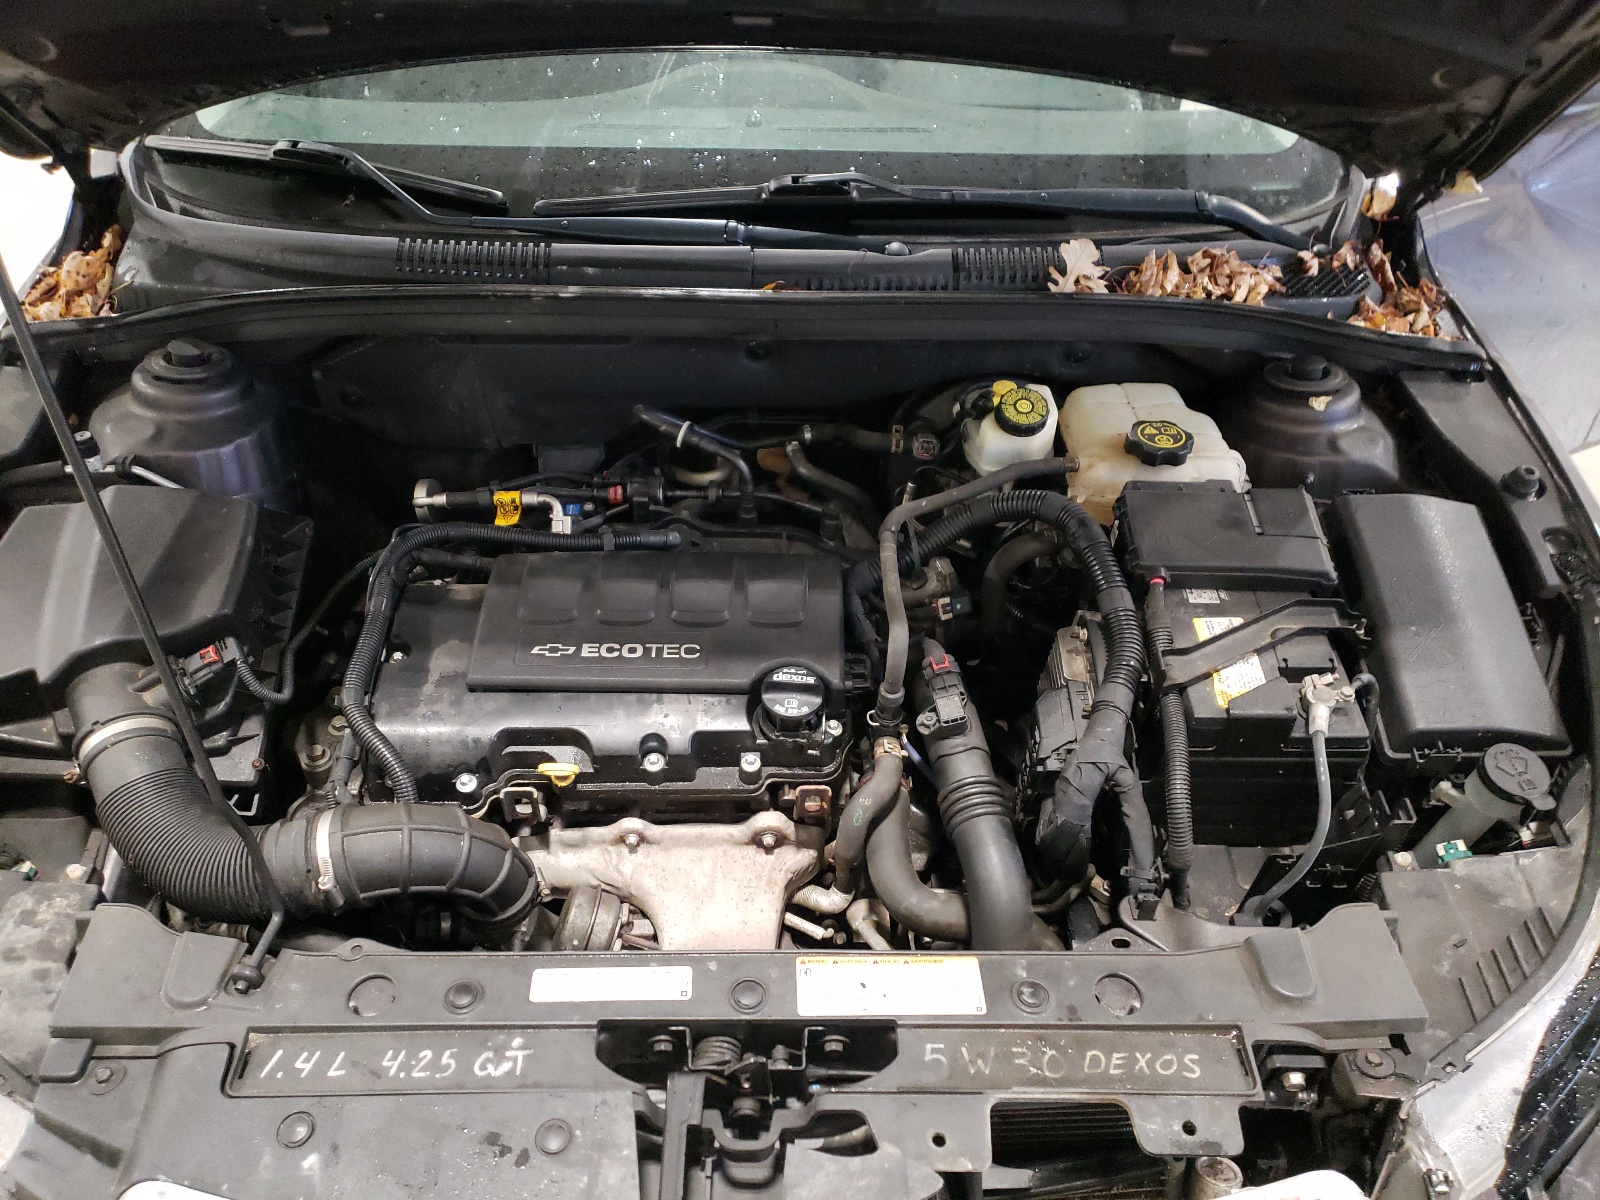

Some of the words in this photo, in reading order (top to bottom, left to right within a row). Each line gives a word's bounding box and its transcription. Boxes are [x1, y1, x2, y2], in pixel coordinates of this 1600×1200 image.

[580, 643, 701, 659] ECOTEC
[773, 671, 816, 684] dexos
[260, 1048, 320, 1079] 1.4
[327, 1051, 347, 1078] L
[381, 1048, 457, 1079] 4.25
[1083, 1050, 1202, 1079] DEXOS
